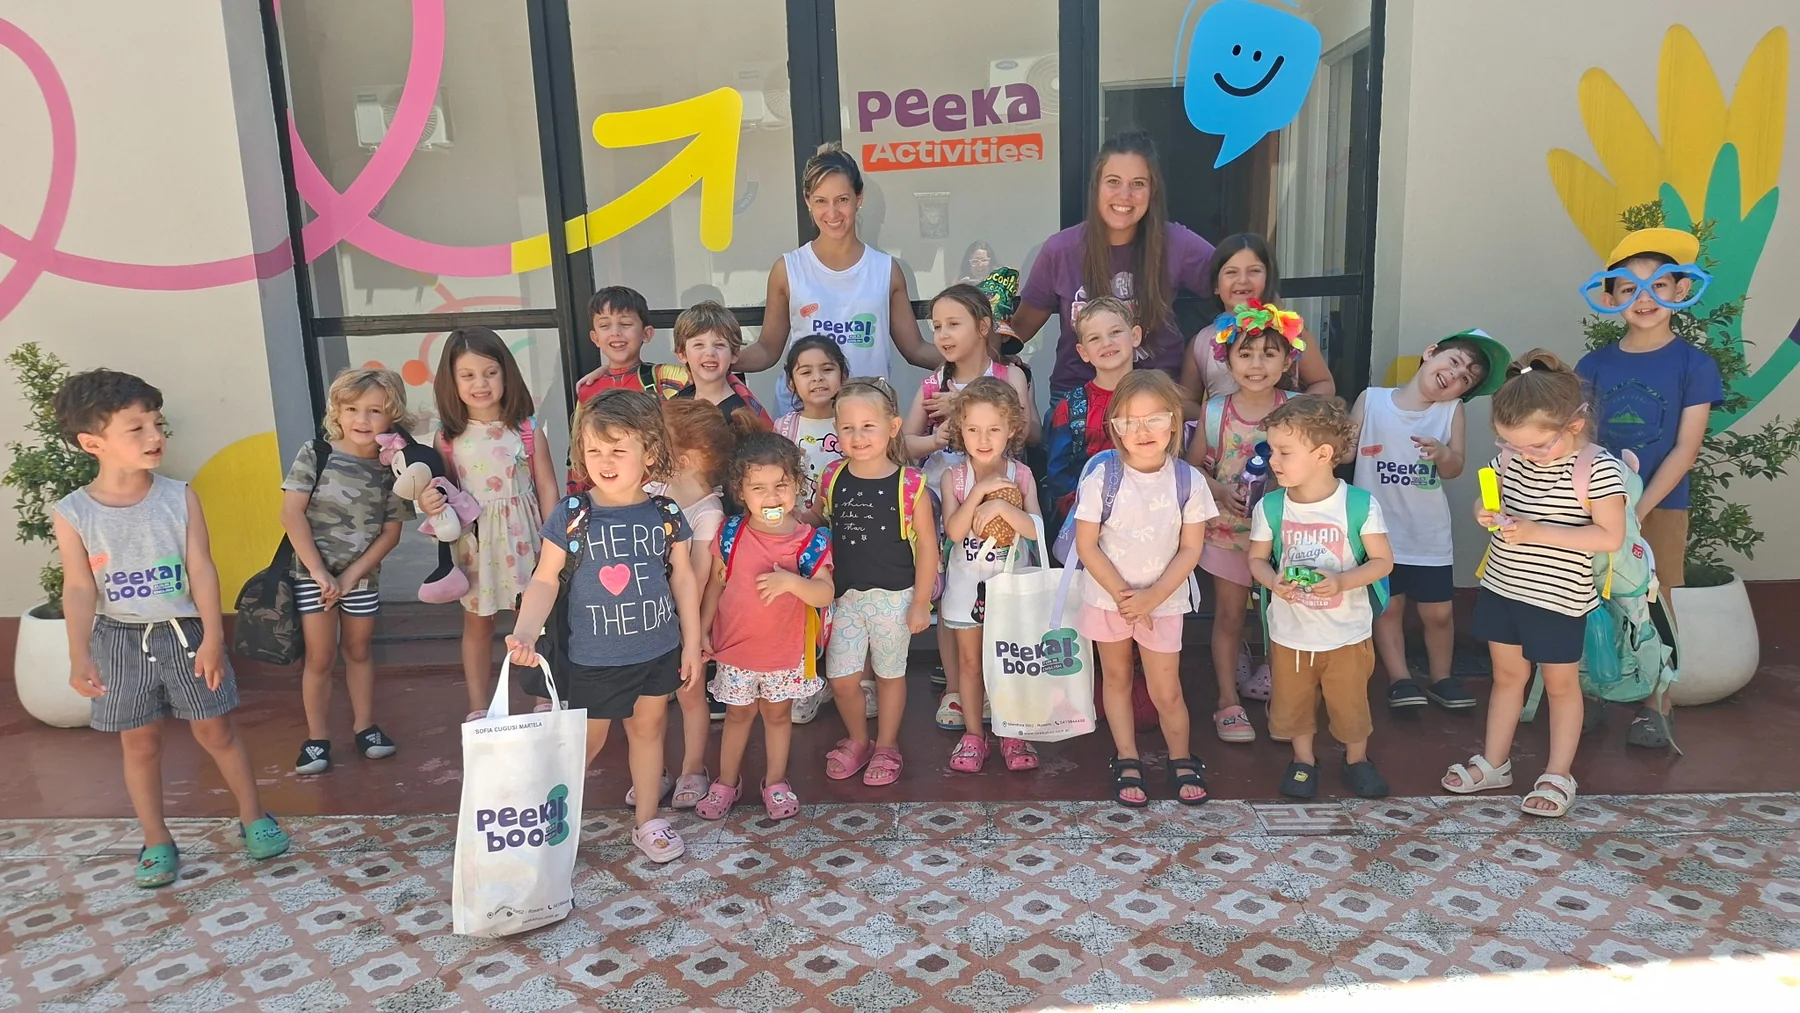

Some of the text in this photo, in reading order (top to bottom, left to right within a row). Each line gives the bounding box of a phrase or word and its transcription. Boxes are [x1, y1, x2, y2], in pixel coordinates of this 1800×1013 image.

[869, 137, 1040, 165] Activities
[1380, 473, 1411, 486] boo
[841, 497, 874, 508] shine
[843, 522, 866, 532] star
[586, 524, 667, 561] HERO
[1287, 546, 1327, 563] Garage
[106, 585, 152, 602] boo
[585, 595, 673, 636] THE DAY
[1002, 658, 1041, 677] boo
[475, 721, 543, 735] SOFIA CUGUSI MARTELA
[486, 828, 544, 853] boo
